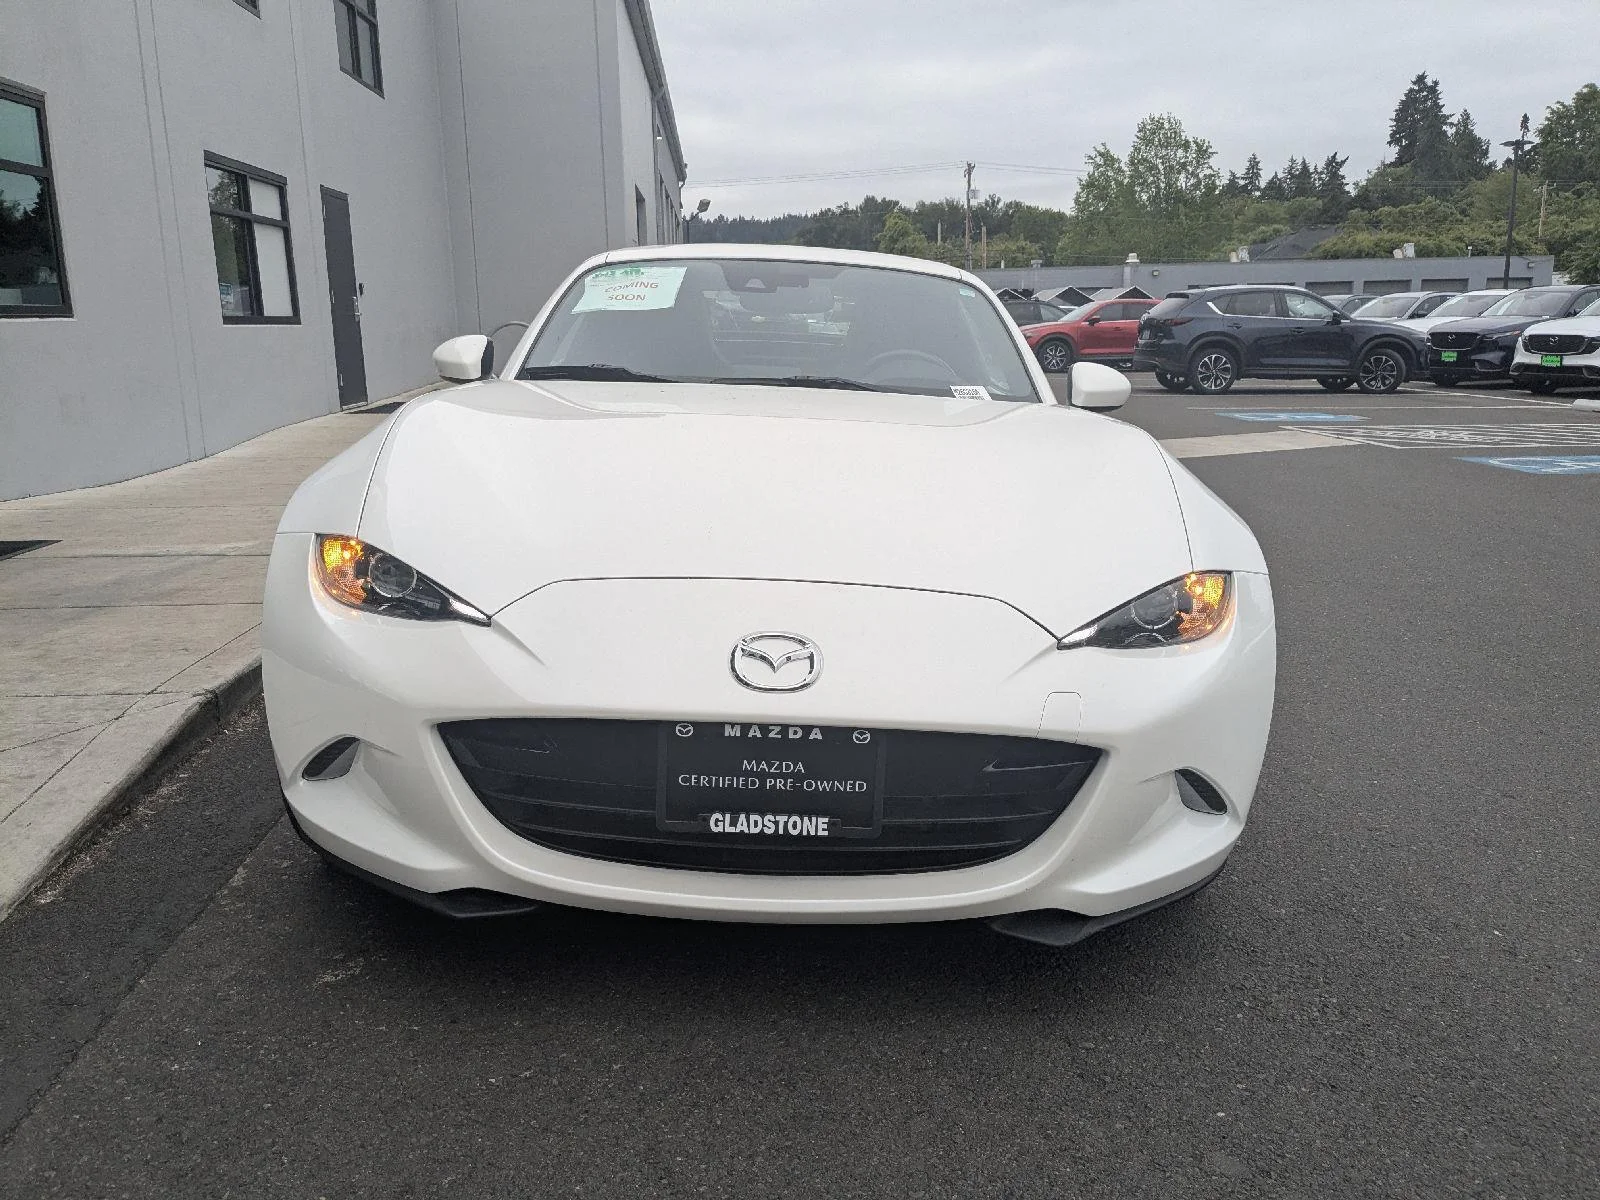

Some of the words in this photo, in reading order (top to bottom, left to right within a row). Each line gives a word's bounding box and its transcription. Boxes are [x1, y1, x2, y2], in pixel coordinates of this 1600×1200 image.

[604, 281, 659, 293] COMING
[724, 724, 823, 740] MAZDA
[742, 759, 805, 773] MAZDA
[678, 774, 759, 789] CERTIFIED
[766, 778, 867, 792] PRE-OWNED
[709, 812, 830, 836] GLADSTONE
